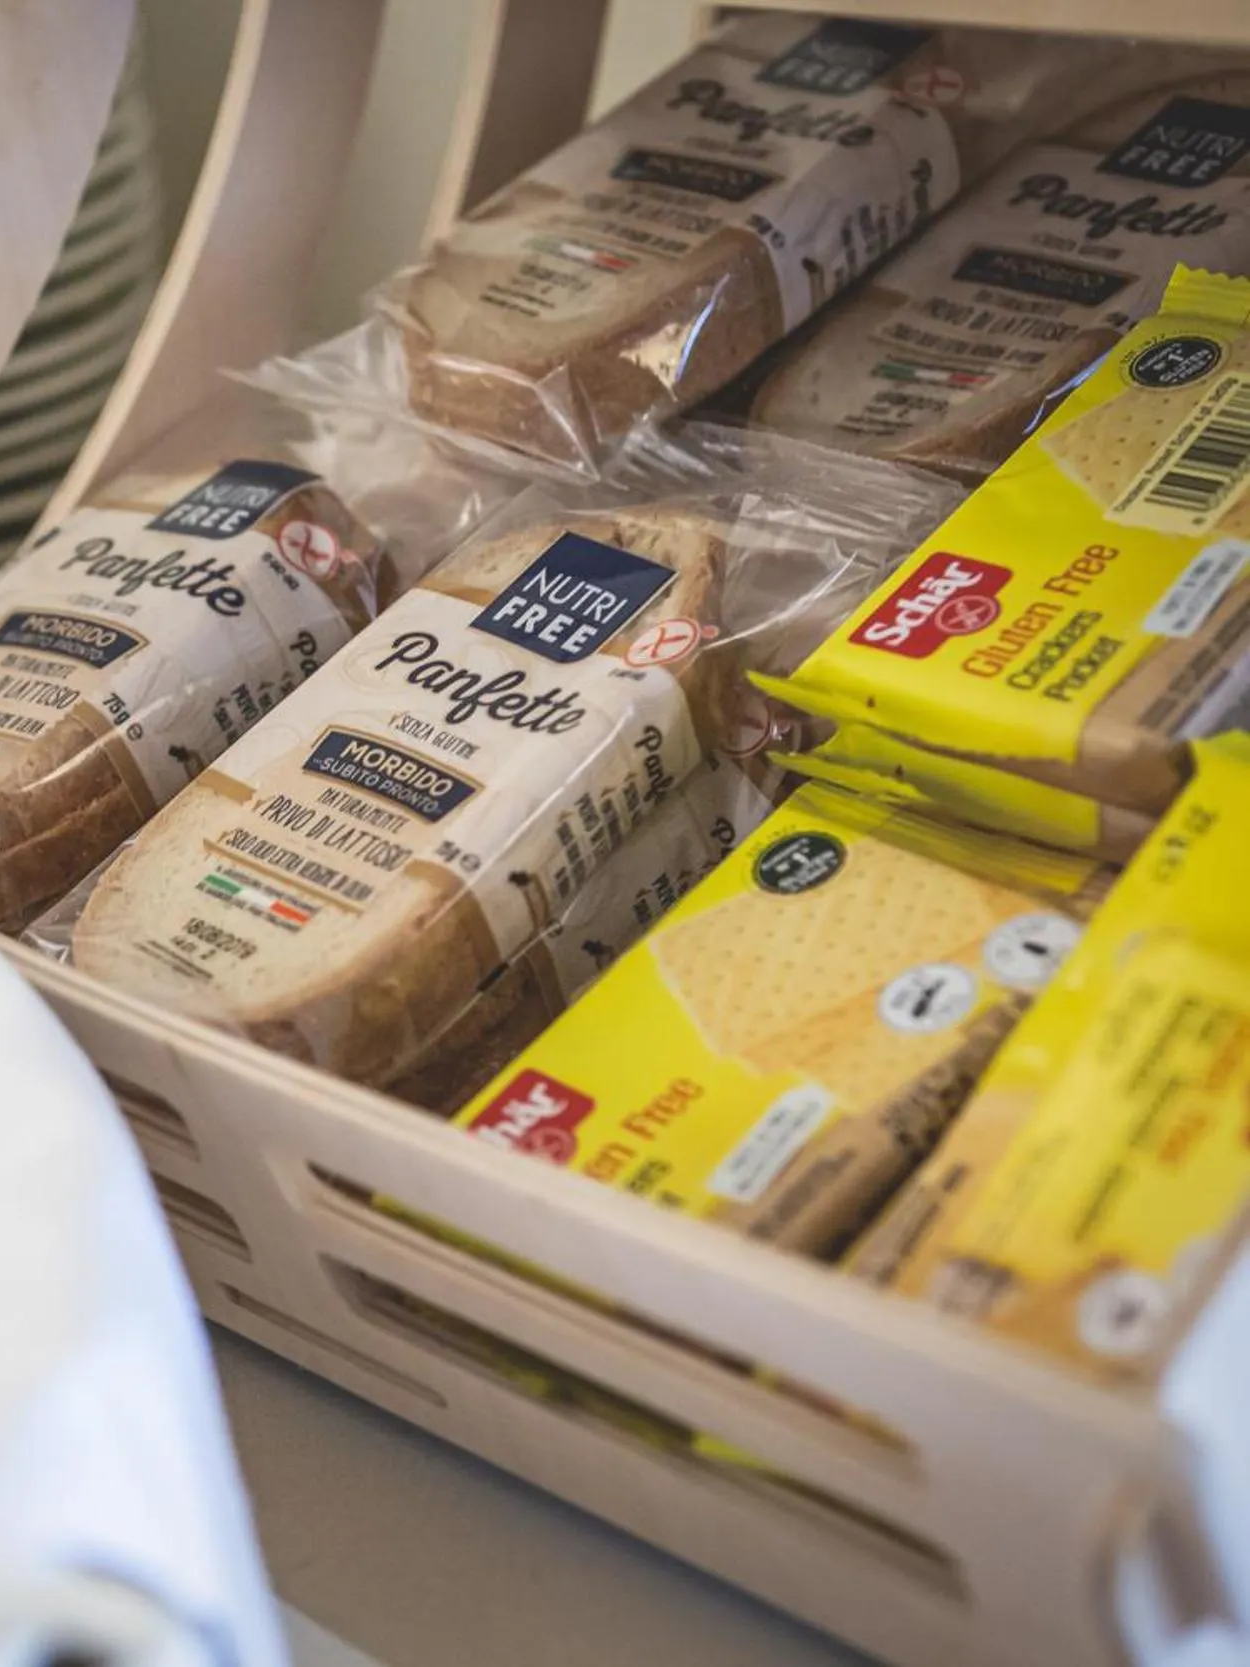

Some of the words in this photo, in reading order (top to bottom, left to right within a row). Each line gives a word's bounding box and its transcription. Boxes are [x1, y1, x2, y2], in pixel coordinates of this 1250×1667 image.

[1118, 146, 1223, 180] FREE
[163, 503, 250, 533] FREE
[196, 483, 277, 508] NUTRI
[58, 537, 246, 617] Panfette
[522, 567, 628, 624] NUTRI
[862, 560, 984, 648] Schär
[21, 614, 117, 648] MORBIDO
[492, 595, 598, 654] FREE
[961, 601, 1064, 679] Gluten
[1042, 543, 1120, 597] Free
[1006, 609, 1104, 691] Crackers
[1042, 633, 1125, 703] Pocket
[374, 631, 587, 735] Panfette
[340, 740, 454, 797] MORBIDO
[261, 793, 316, 832] PRIVO
[306, 815, 336, 840] DI
[620, 1076, 705, 1142] Free
